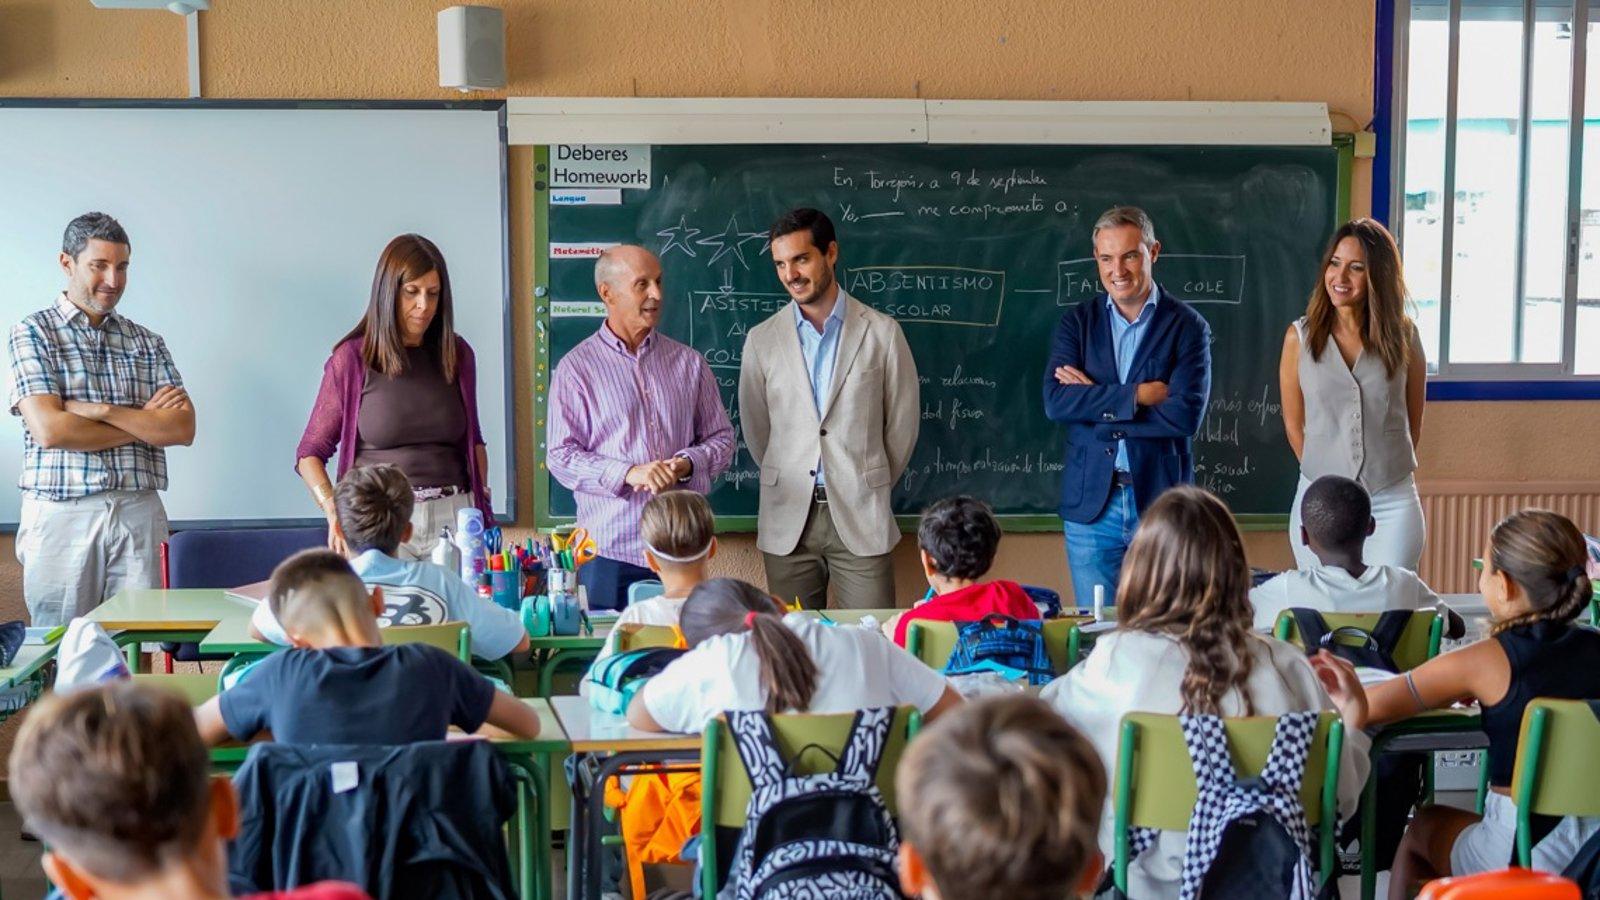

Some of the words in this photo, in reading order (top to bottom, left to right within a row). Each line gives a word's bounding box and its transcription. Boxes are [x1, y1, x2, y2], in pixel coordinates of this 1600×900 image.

[558, 144, 628, 161] Deberes
[554, 168, 648, 184] Homework
[930, 180, 940, 189] a
[951, 170, 961, 186] 9
[966, 168, 980, 186] de
[850, 271, 994, 293] ABSENTISMO
[1064, 271, 1104, 297] FAL
[1184, 279, 1224, 294] COLE
[704, 348, 743, 363] COL
